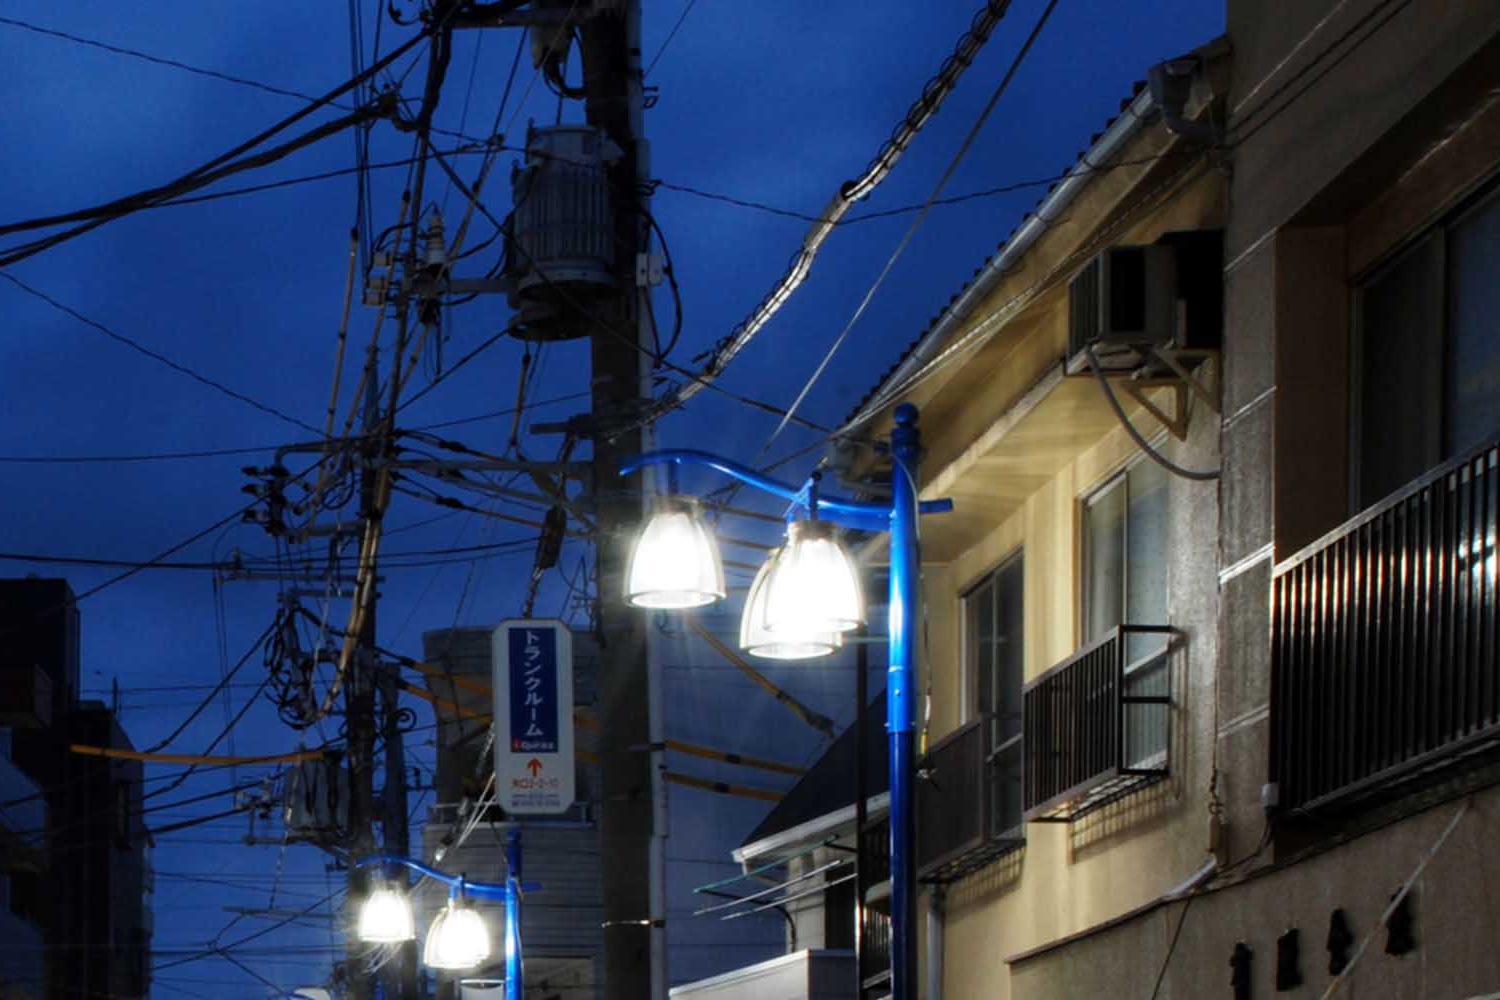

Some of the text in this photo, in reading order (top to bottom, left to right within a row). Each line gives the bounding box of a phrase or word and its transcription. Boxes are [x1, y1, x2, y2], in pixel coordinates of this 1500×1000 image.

[523, 630, 544, 738] トランクルーム
